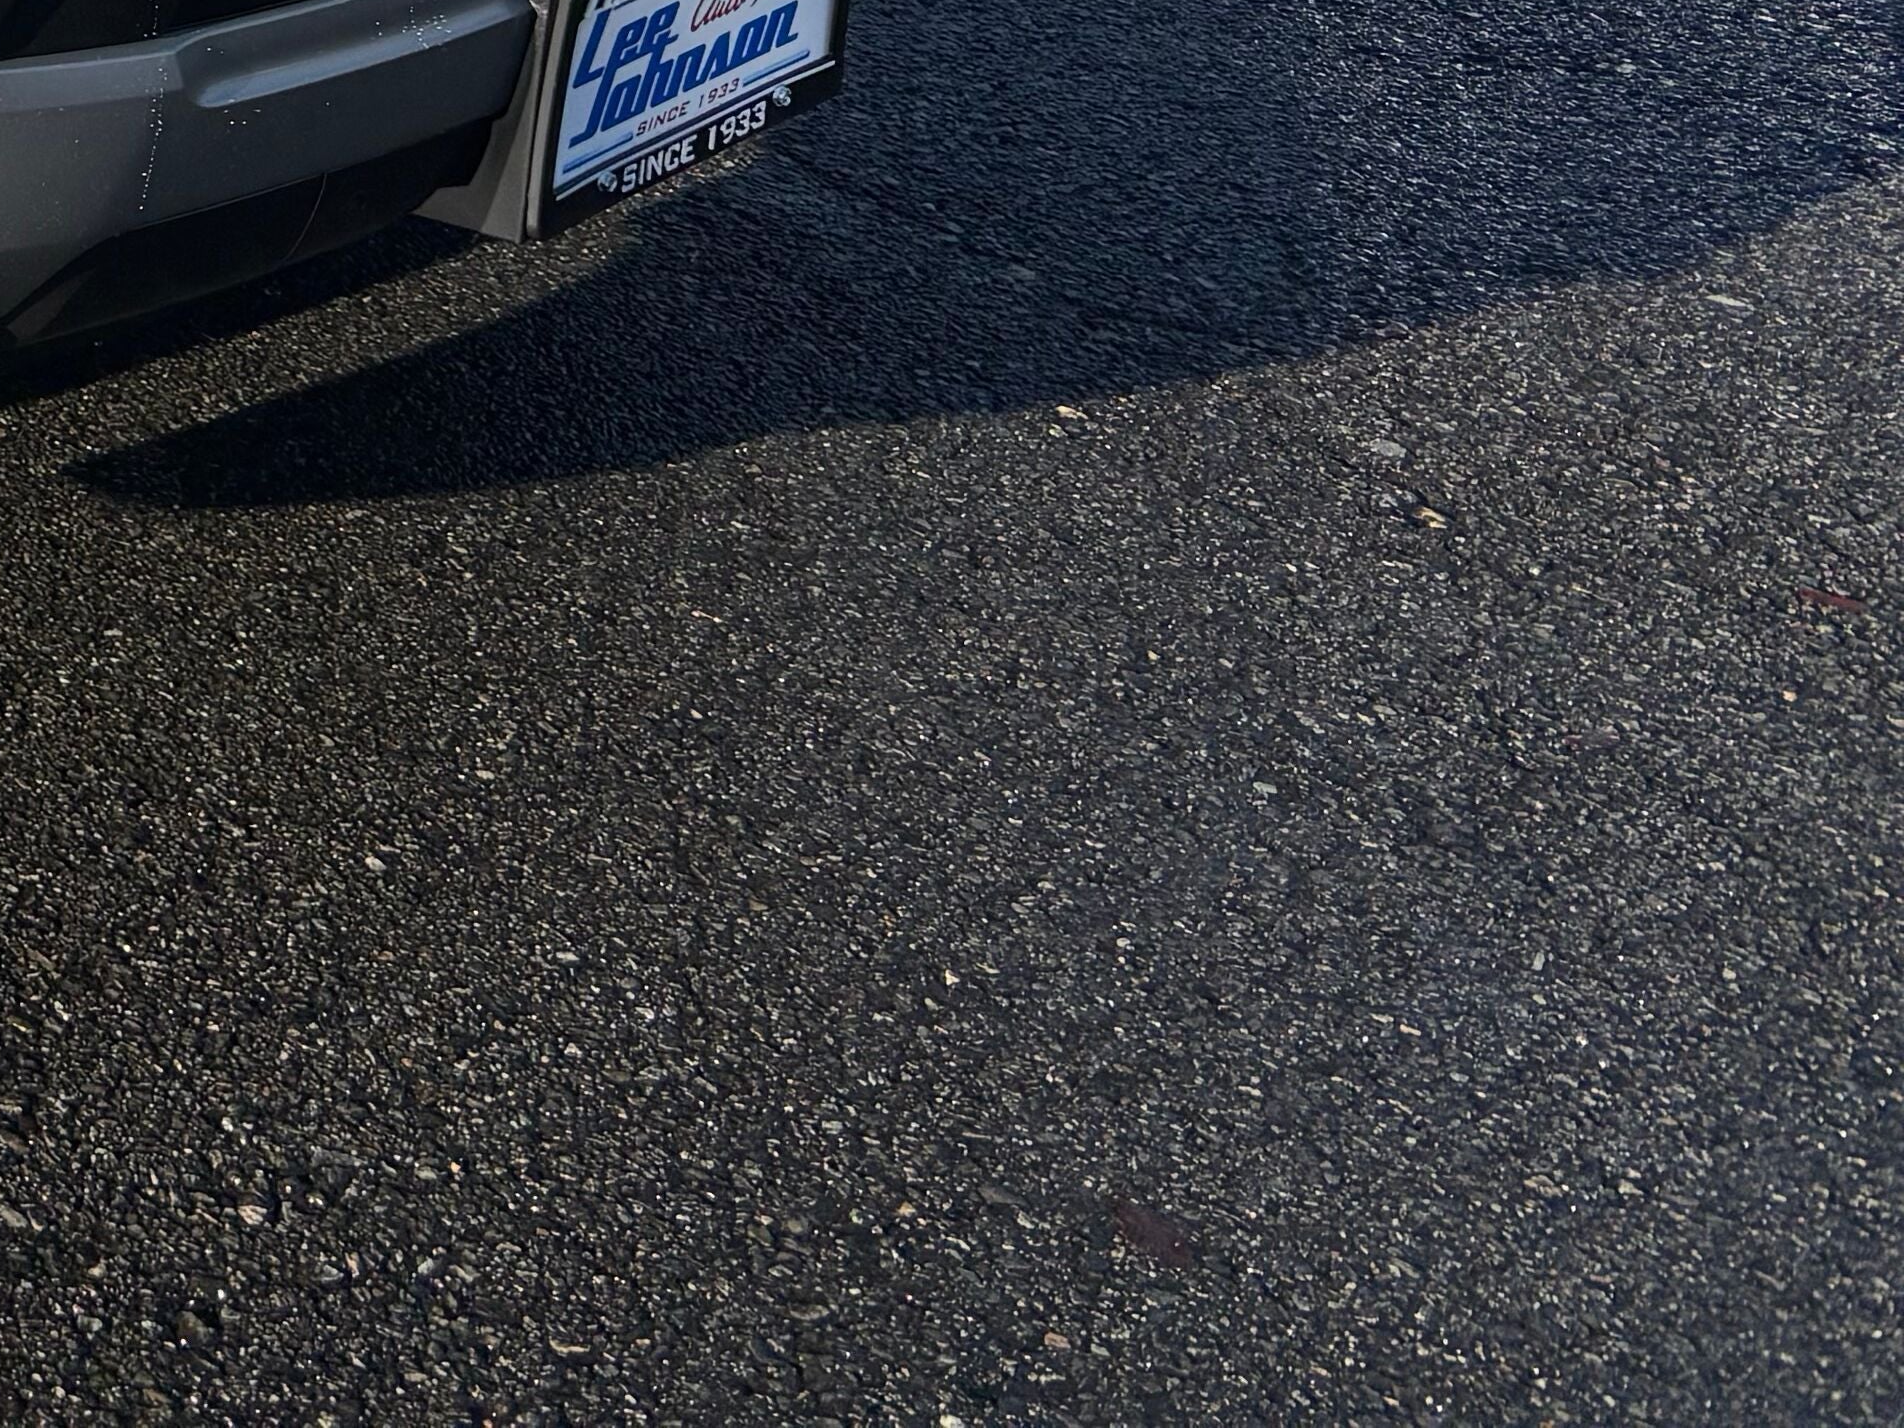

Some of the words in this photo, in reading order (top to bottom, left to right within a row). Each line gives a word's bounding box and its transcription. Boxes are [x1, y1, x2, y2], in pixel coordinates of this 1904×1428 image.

[568, 0, 799, 149] Johnson
[572, 1, 681, 89] Lee
[621, 135, 698, 194] SINCE
[707, 100, 768, 151] 1933
[636, 100, 691, 137] SINCE
[698, 77, 740, 109] 1933
